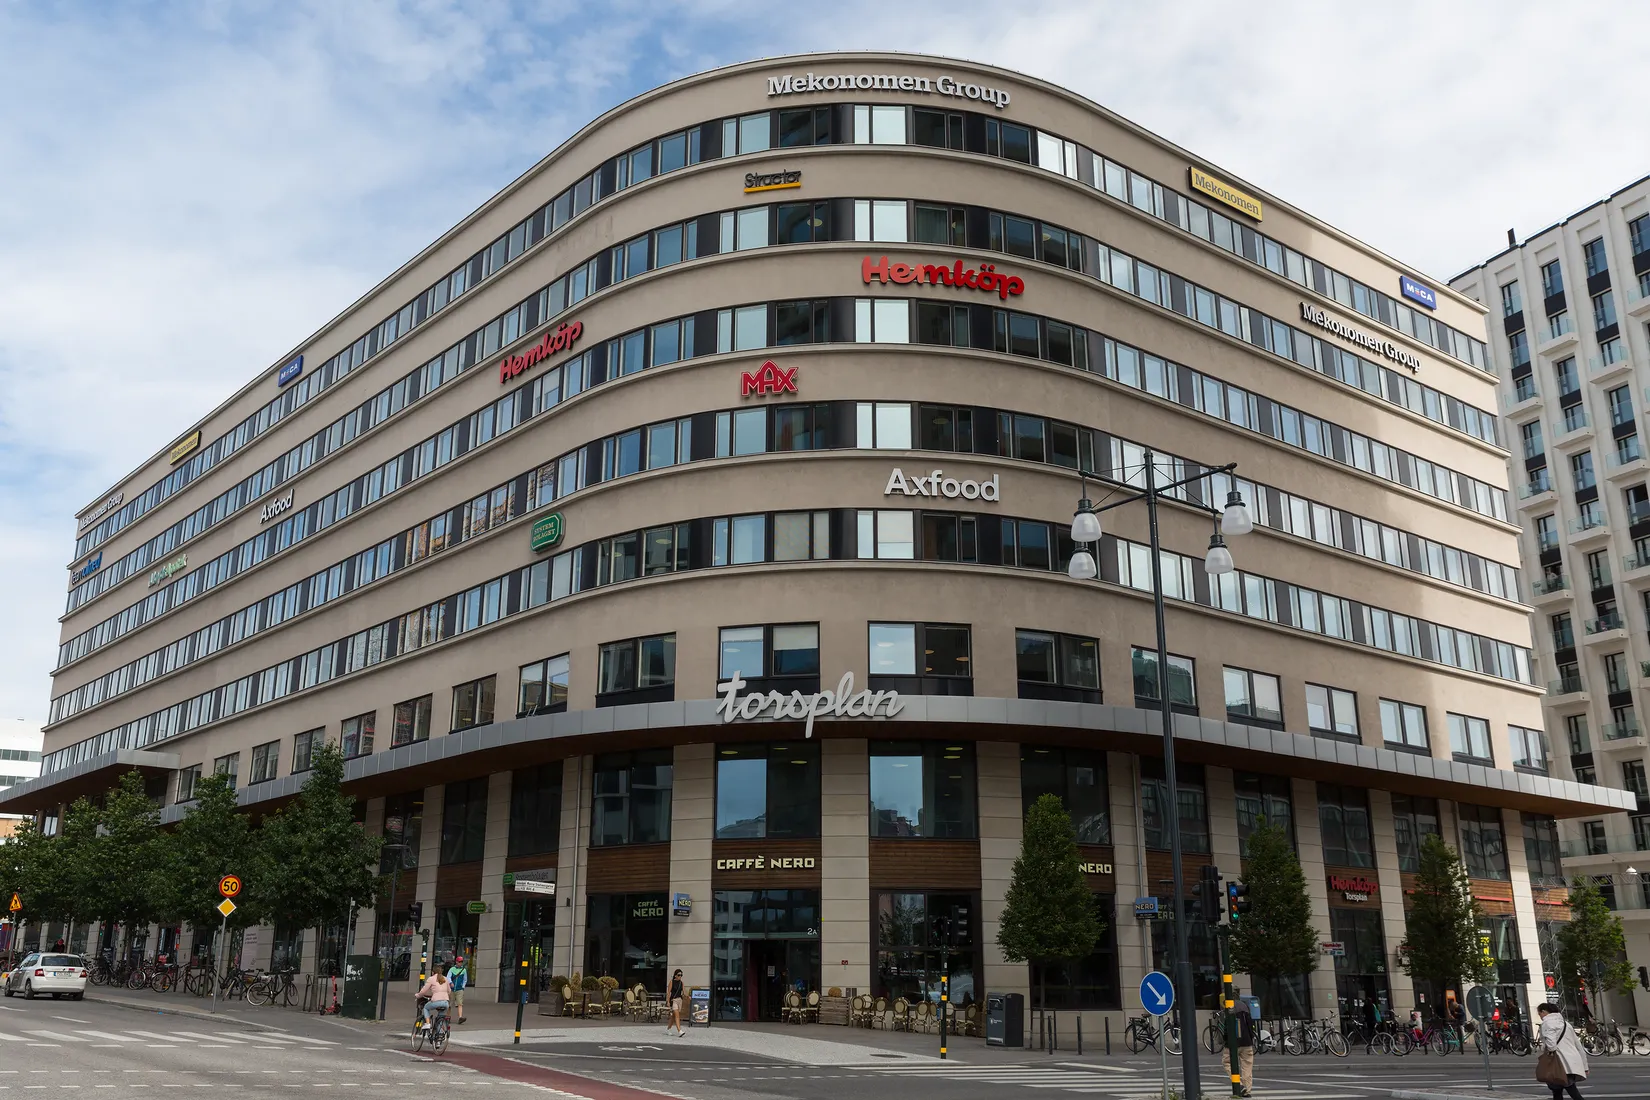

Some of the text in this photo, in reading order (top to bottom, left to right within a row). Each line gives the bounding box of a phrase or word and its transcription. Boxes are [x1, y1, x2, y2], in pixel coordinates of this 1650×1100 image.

[767, 73, 1011, 109] Mekonomen Group
[744, 168, 801, 188] Structor
[1195, 173, 1259, 215] Mekonomen
[862, 255, 1025, 300] Hemköp
[1301, 301, 1422, 372] Mekonomen Group
[500, 321, 583, 384] Hemköp
[741, 360, 798, 396] MAX
[884, 467, 1000, 501] Axfood
[259, 488, 294, 524] Axfood
[716, 670, 906, 739] torsplan
[717, 855, 815, 870] CAFFÈ NERO
[1078, 862, 1112, 874] NERO
[223, 881, 238, 892] 50
[1330, 875, 1378, 894] Hemköp
[1345, 892, 1368, 902] Torsplan
[633, 908, 664, 917] NERO
[678, 899, 692, 907] NERO
[807, 927, 818, 935] 2A
